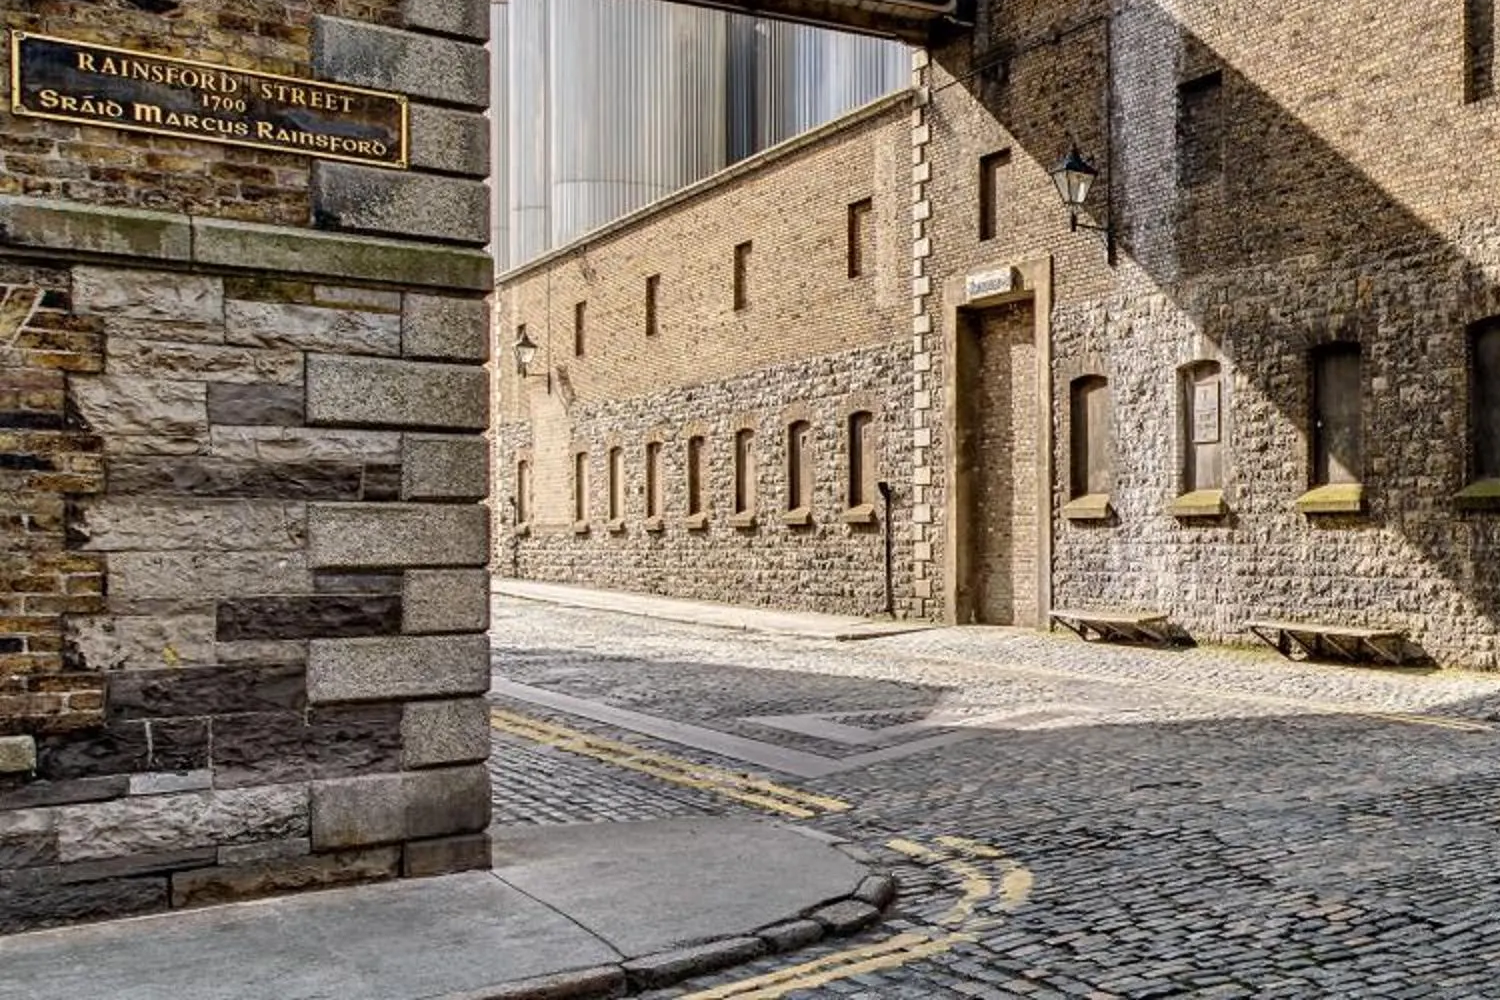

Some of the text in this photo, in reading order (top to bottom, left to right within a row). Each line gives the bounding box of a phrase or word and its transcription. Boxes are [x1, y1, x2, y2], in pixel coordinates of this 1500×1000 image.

[78, 51, 354, 114] RAINSFORD STREET
[202, 94, 247, 114] 1700
